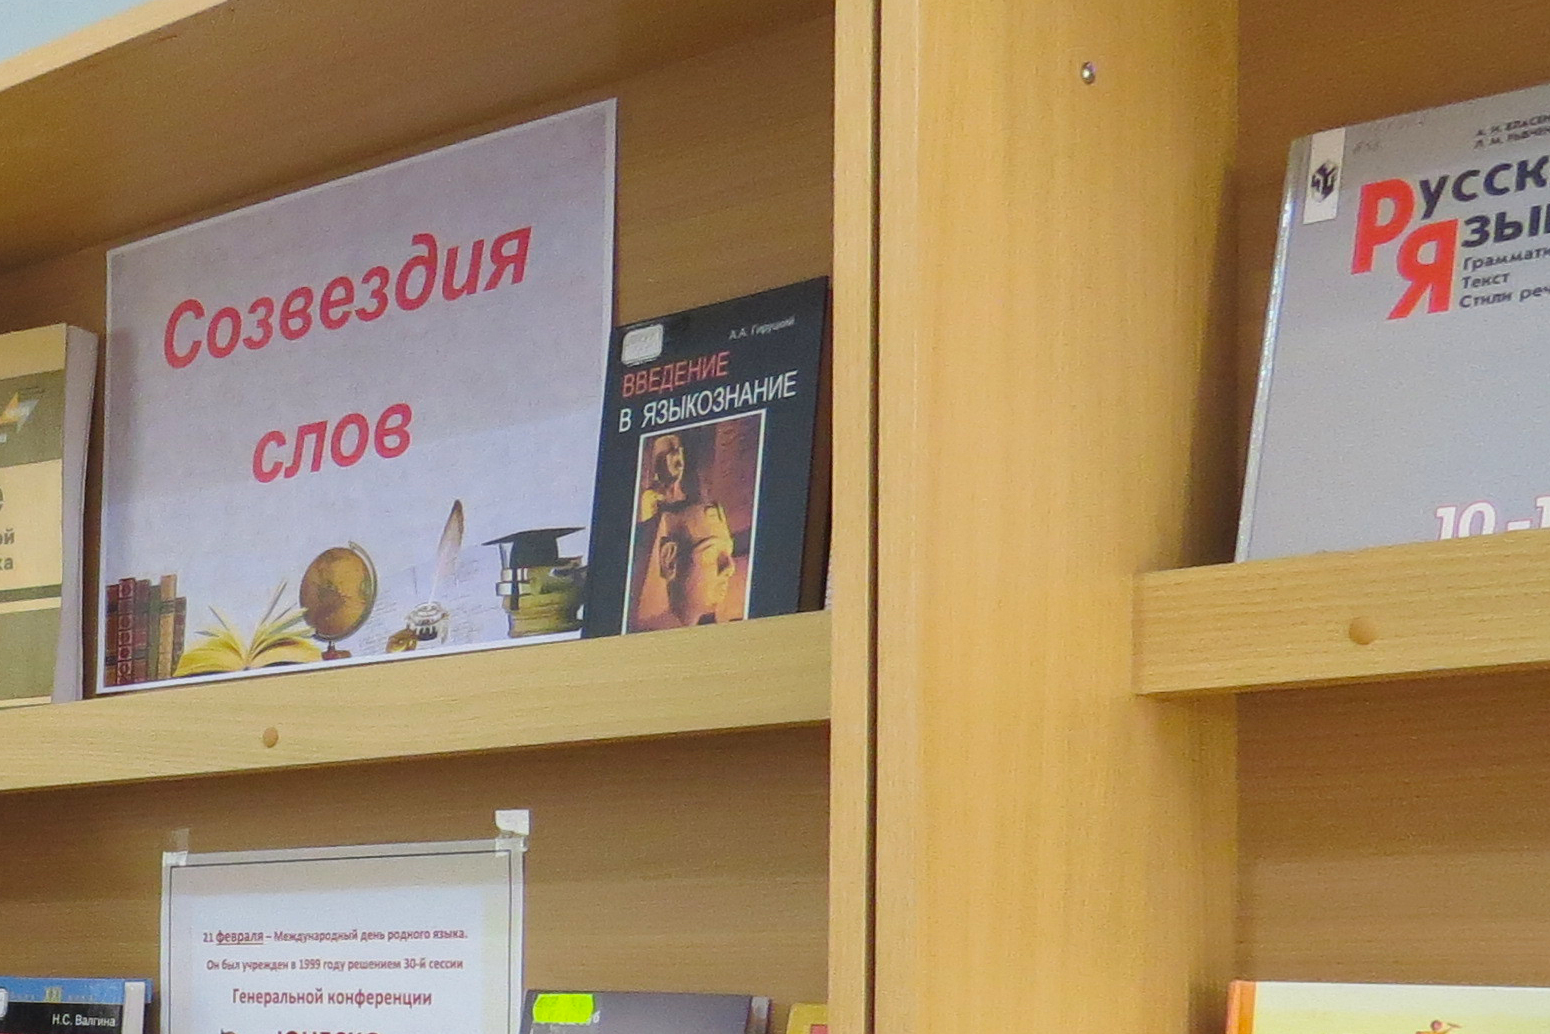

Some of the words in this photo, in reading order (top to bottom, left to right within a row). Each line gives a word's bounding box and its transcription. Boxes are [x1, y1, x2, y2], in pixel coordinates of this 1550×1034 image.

[1462, 272, 1510, 289] Текст
[162, 225, 533, 368] Созвездия
[1459, 291, 1512, 308] Стили
[622, 351, 731, 398] ВВЕДЕНИЕ
[618, 408, 632, 433] В
[640, 370, 798, 428] ЯЗЫКОЗНАНИЕ
[251, 400, 413, 484] слов
[203, 932, 214, 943] 21
[216, 930, 264, 945] февраля
[274, 929, 358, 943] Международный
[360, 931, 385, 942] день
[387, 930, 430, 942] родного
[433, 929, 468, 939] языка.
[206, 959, 219, 970] Он
[222, 958, 240, 970] был
[242, 960, 288, 972] учрежден
[299, 959, 321, 970] 1999
[323, 960, 345, 972] году
[347, 960, 401, 971] решением
[404, 957, 427, 970] 30-й
[429, 960, 463, 970] сессии
[232, 987, 323, 1008] Генеральной
[328, 988, 432, 1009] конференции
[52, 1013, 72, 1026] Н.С.
[75, 1014, 116, 1027] Валгина
